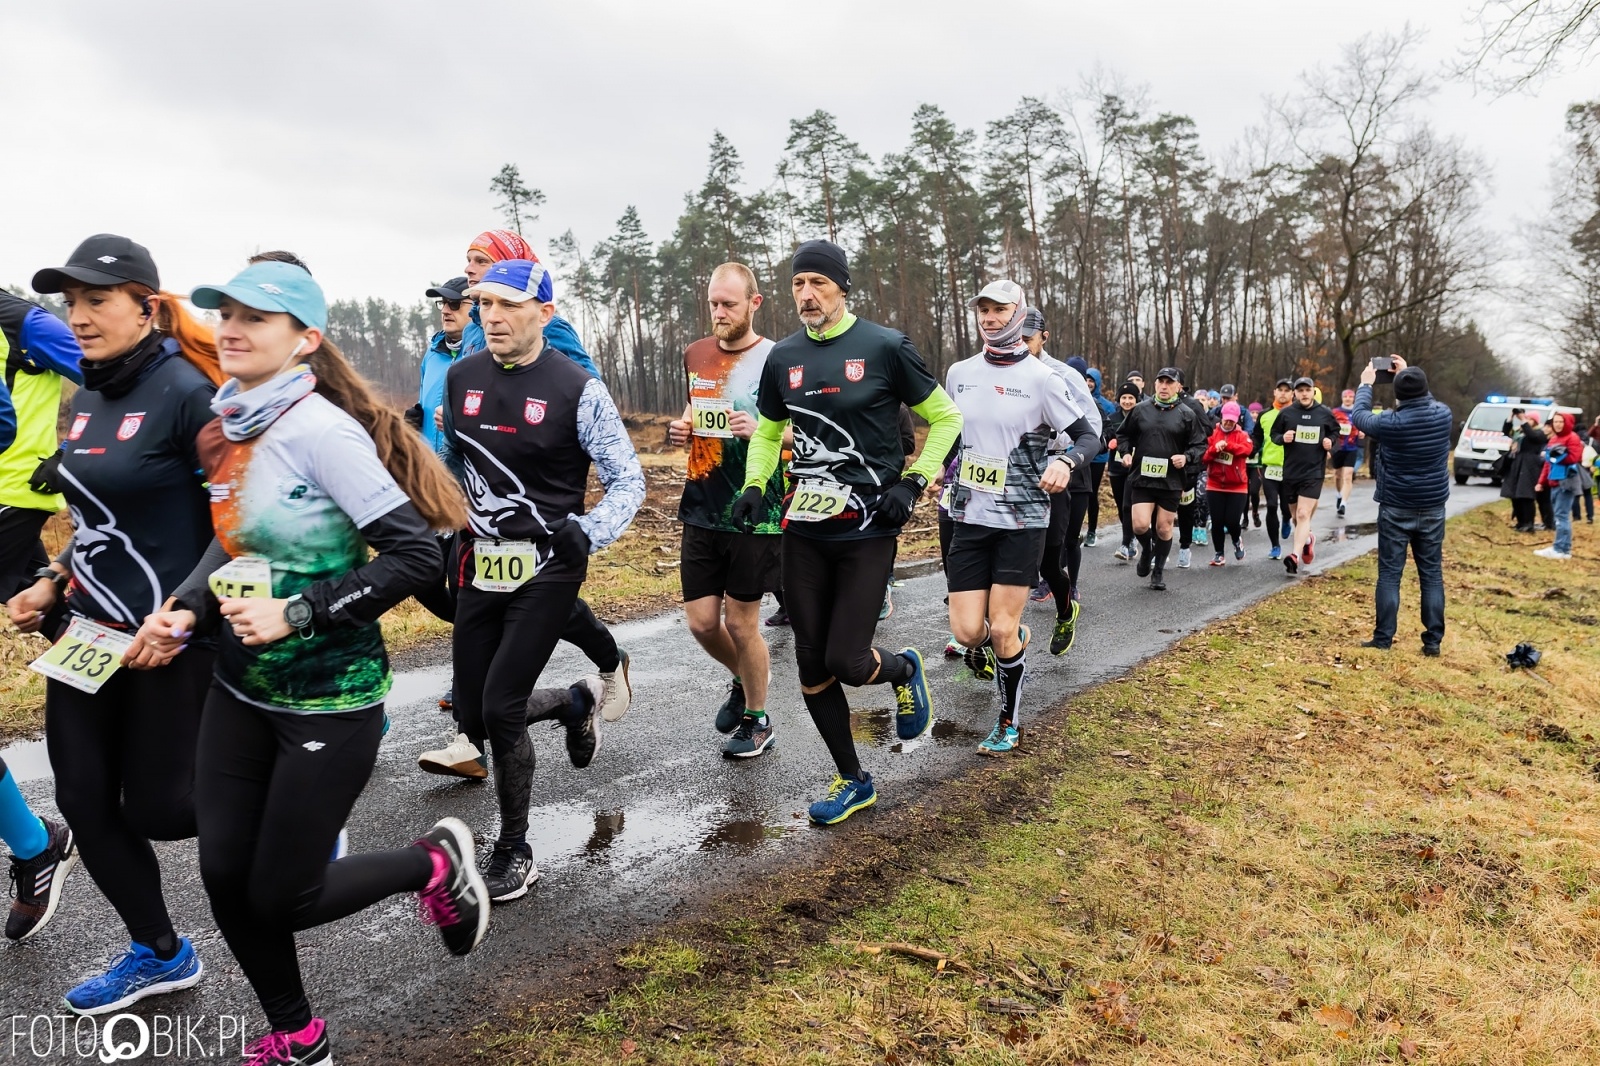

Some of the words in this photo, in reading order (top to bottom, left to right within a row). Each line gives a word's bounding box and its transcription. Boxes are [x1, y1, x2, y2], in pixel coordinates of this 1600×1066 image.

[1005, 391, 1031, 399] MARATHON
[697, 410, 726, 430] 190
[968, 464, 998, 486] 194
[1146, 464, 1163, 473] 167
[796, 492, 837, 515] 222
[482, 556, 523, 580] 210
[328, 589, 363, 614] RUNNING
[59, 643, 112, 677] 193
